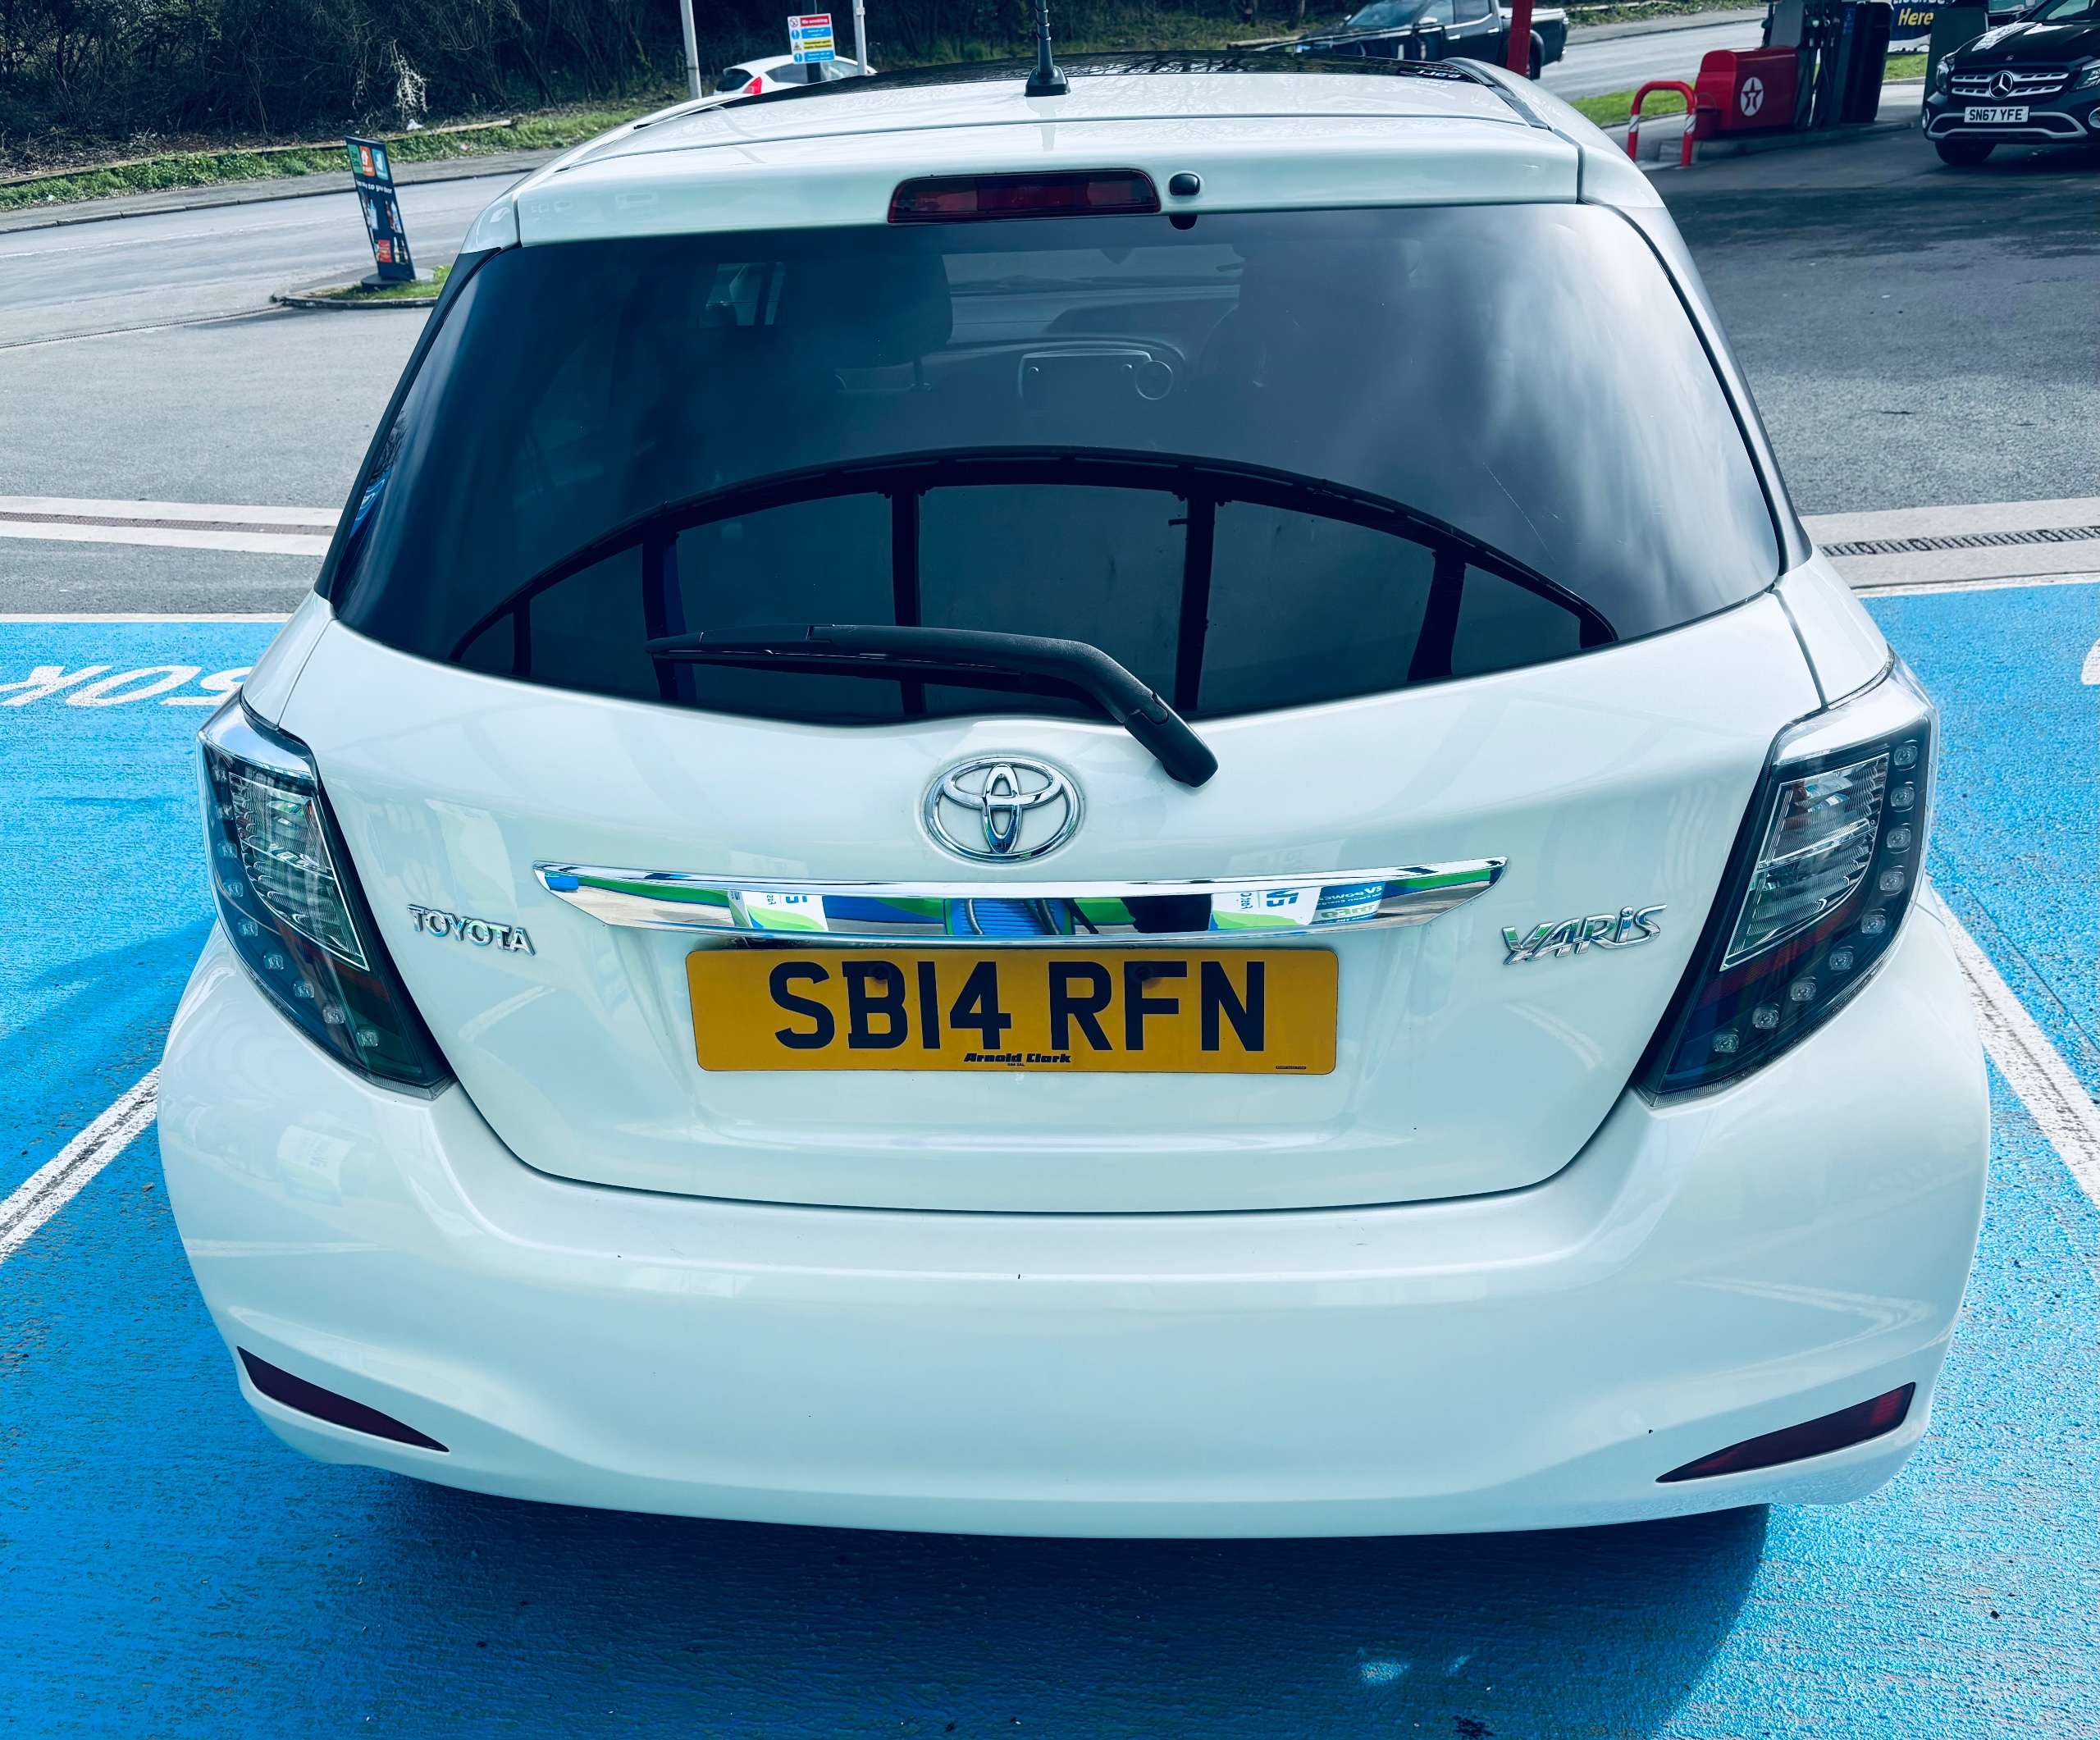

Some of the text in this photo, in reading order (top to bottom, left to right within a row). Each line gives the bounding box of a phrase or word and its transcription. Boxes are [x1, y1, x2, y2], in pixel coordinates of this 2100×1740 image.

[1897, 7, 1934, 26] Here
[1969, 108, 2023, 121] SN67 YFE
[407, 904, 536, 956] TOYOTA
[769, 961, 1266, 1051] SB14 RFN
[963, 1053, 1071, 1063] Arnold Clark
